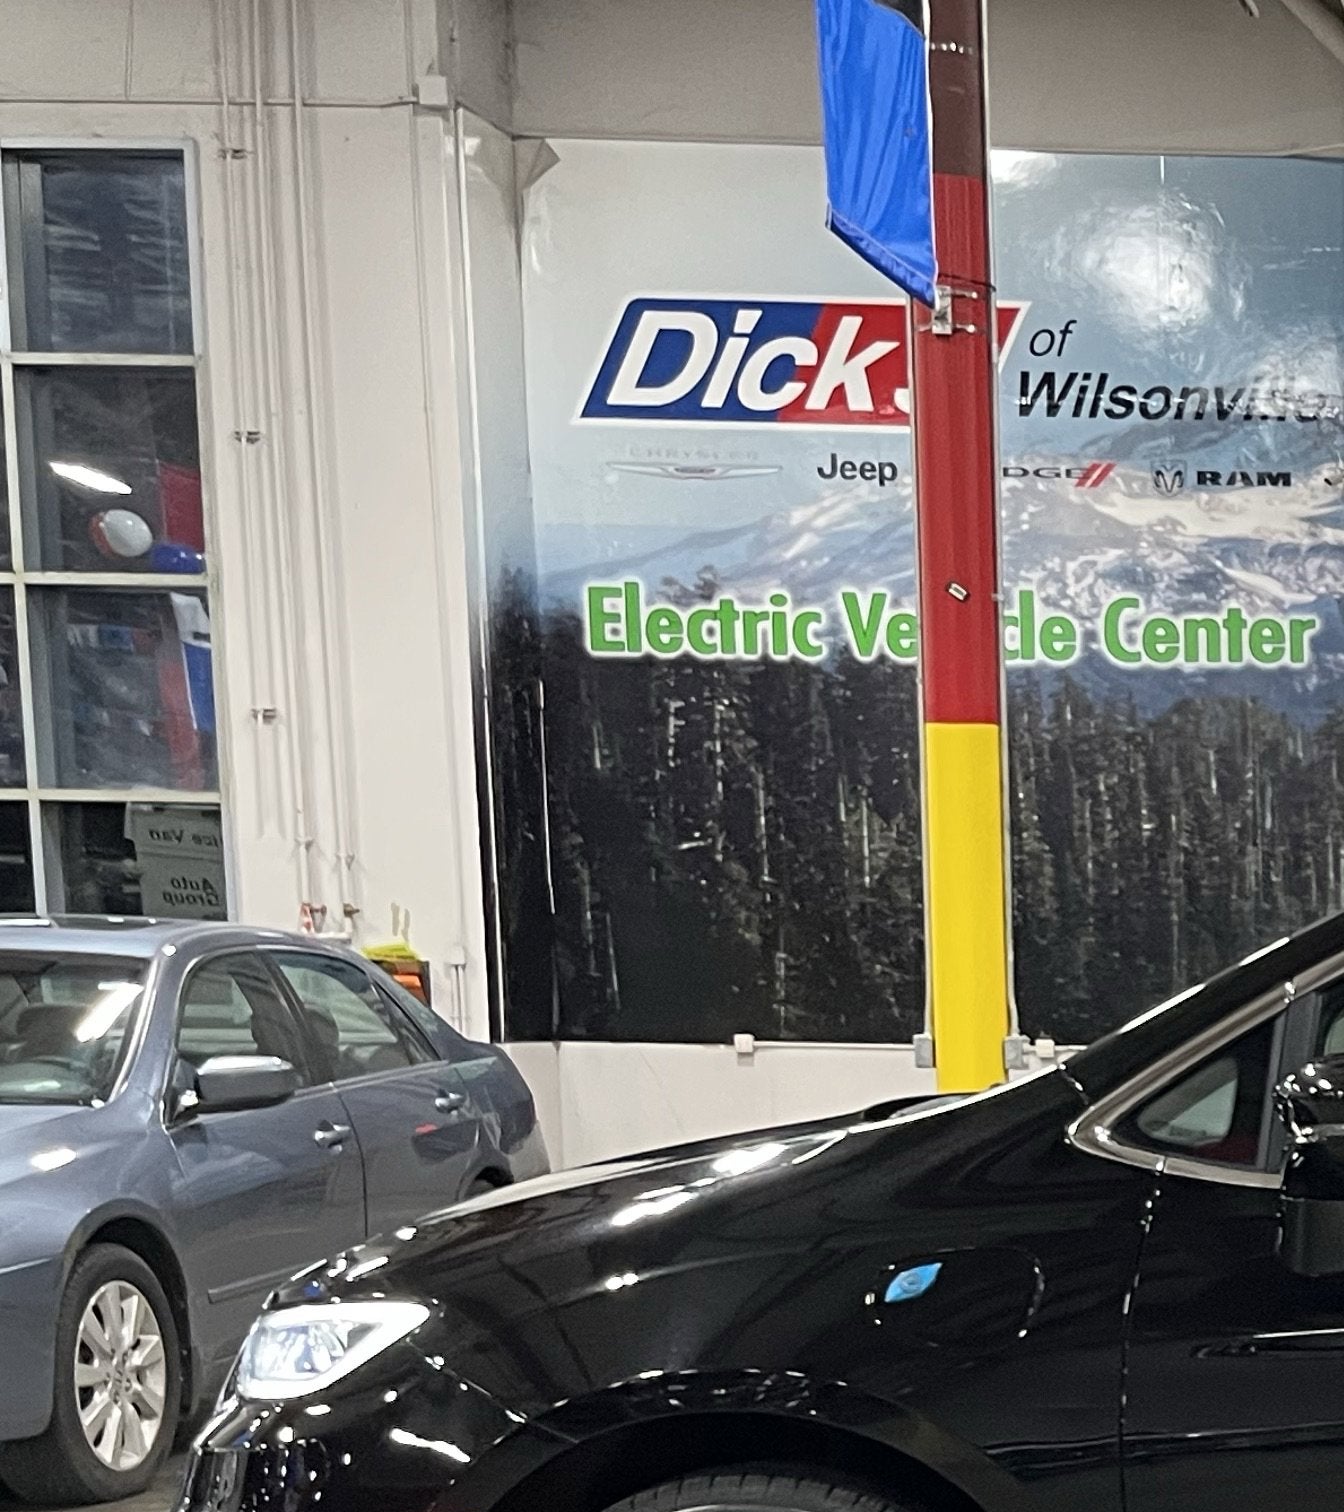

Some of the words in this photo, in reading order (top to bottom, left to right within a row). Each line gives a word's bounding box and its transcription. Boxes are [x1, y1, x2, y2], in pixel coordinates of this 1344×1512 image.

[1028, 319, 1077, 358] of
[606, 309, 912, 414] Dick
[1018, 371, 1327, 423] Wilsonv
[817, 452, 899, 487] Jeep
[1002, 466, 1091, 479] DGE
[1196, 470, 1292, 487] RAM
[587, 581, 824, 658] Electric
[841, 590, 1077, 662] Vele
[1103, 597, 1317, 664] Center
